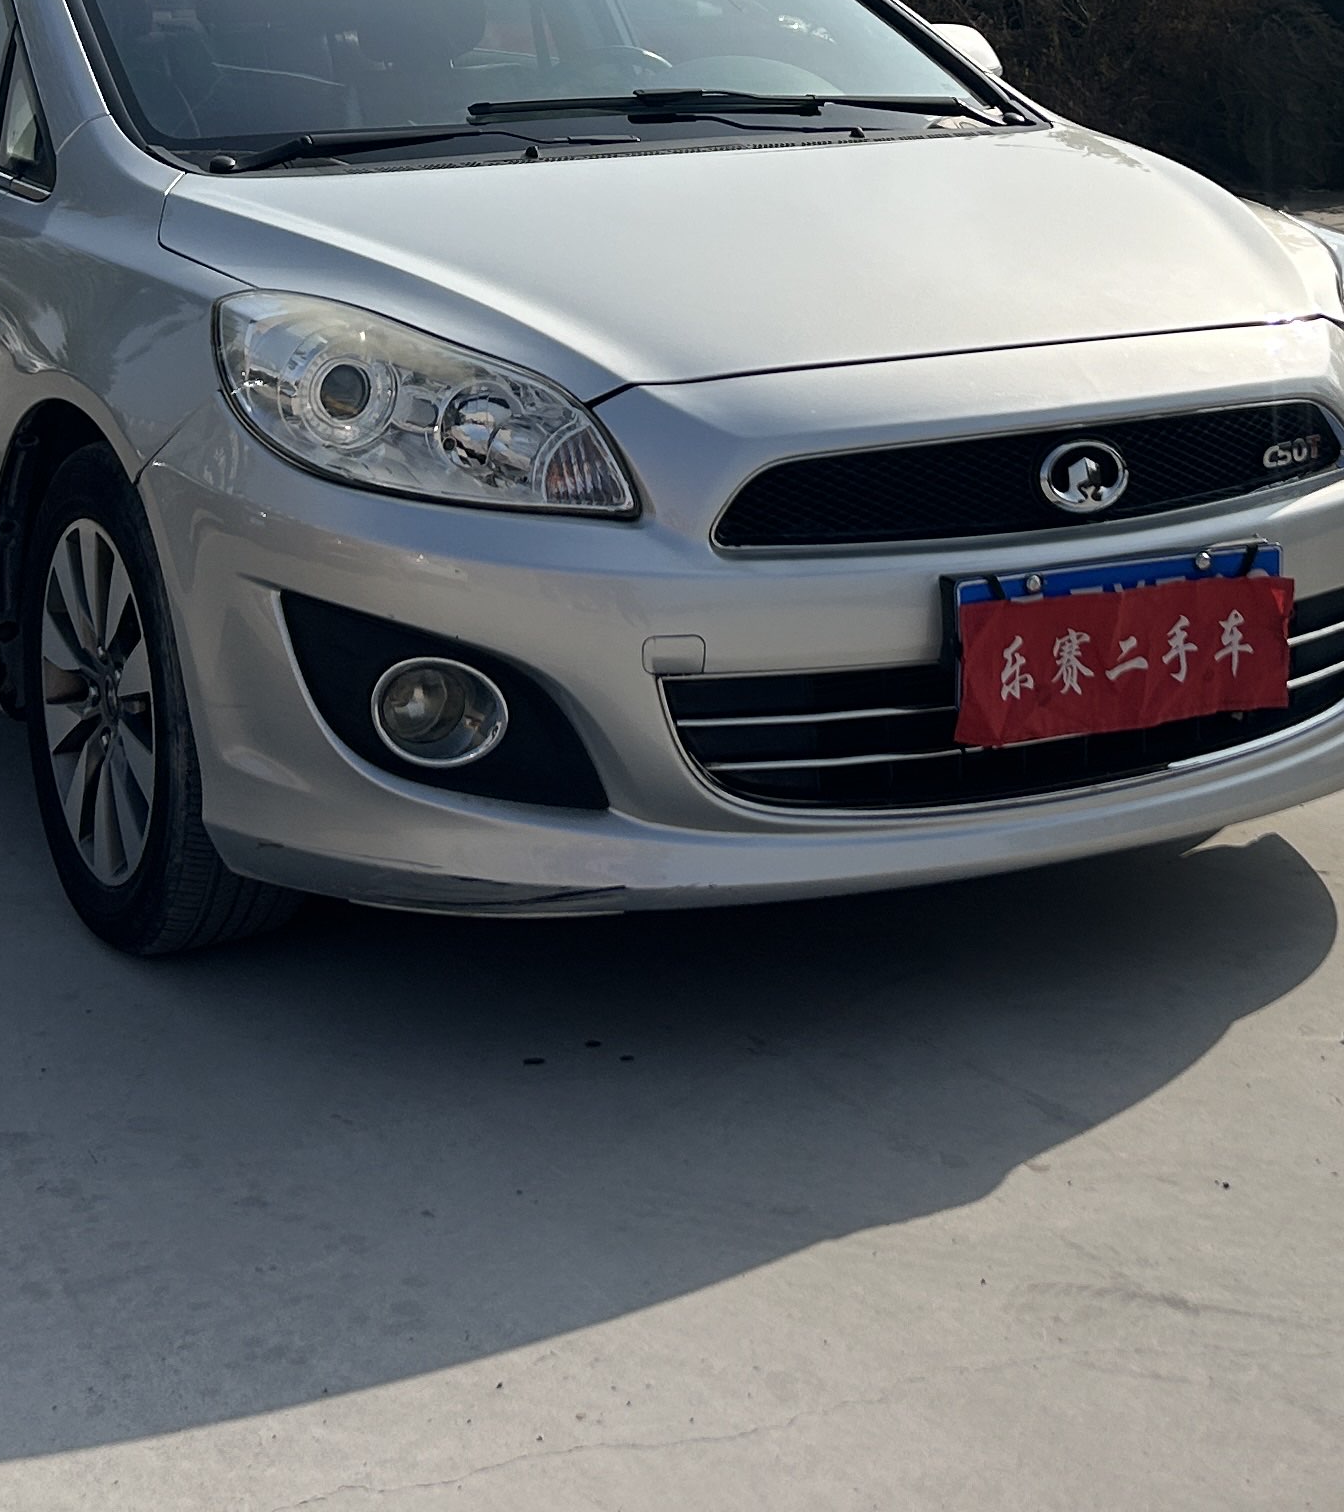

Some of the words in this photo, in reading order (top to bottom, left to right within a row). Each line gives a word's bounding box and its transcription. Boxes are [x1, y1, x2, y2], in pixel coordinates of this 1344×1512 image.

[1262, 433, 1322, 469] C50T
[1000, 608, 1255, 702] 乐赛二手车
